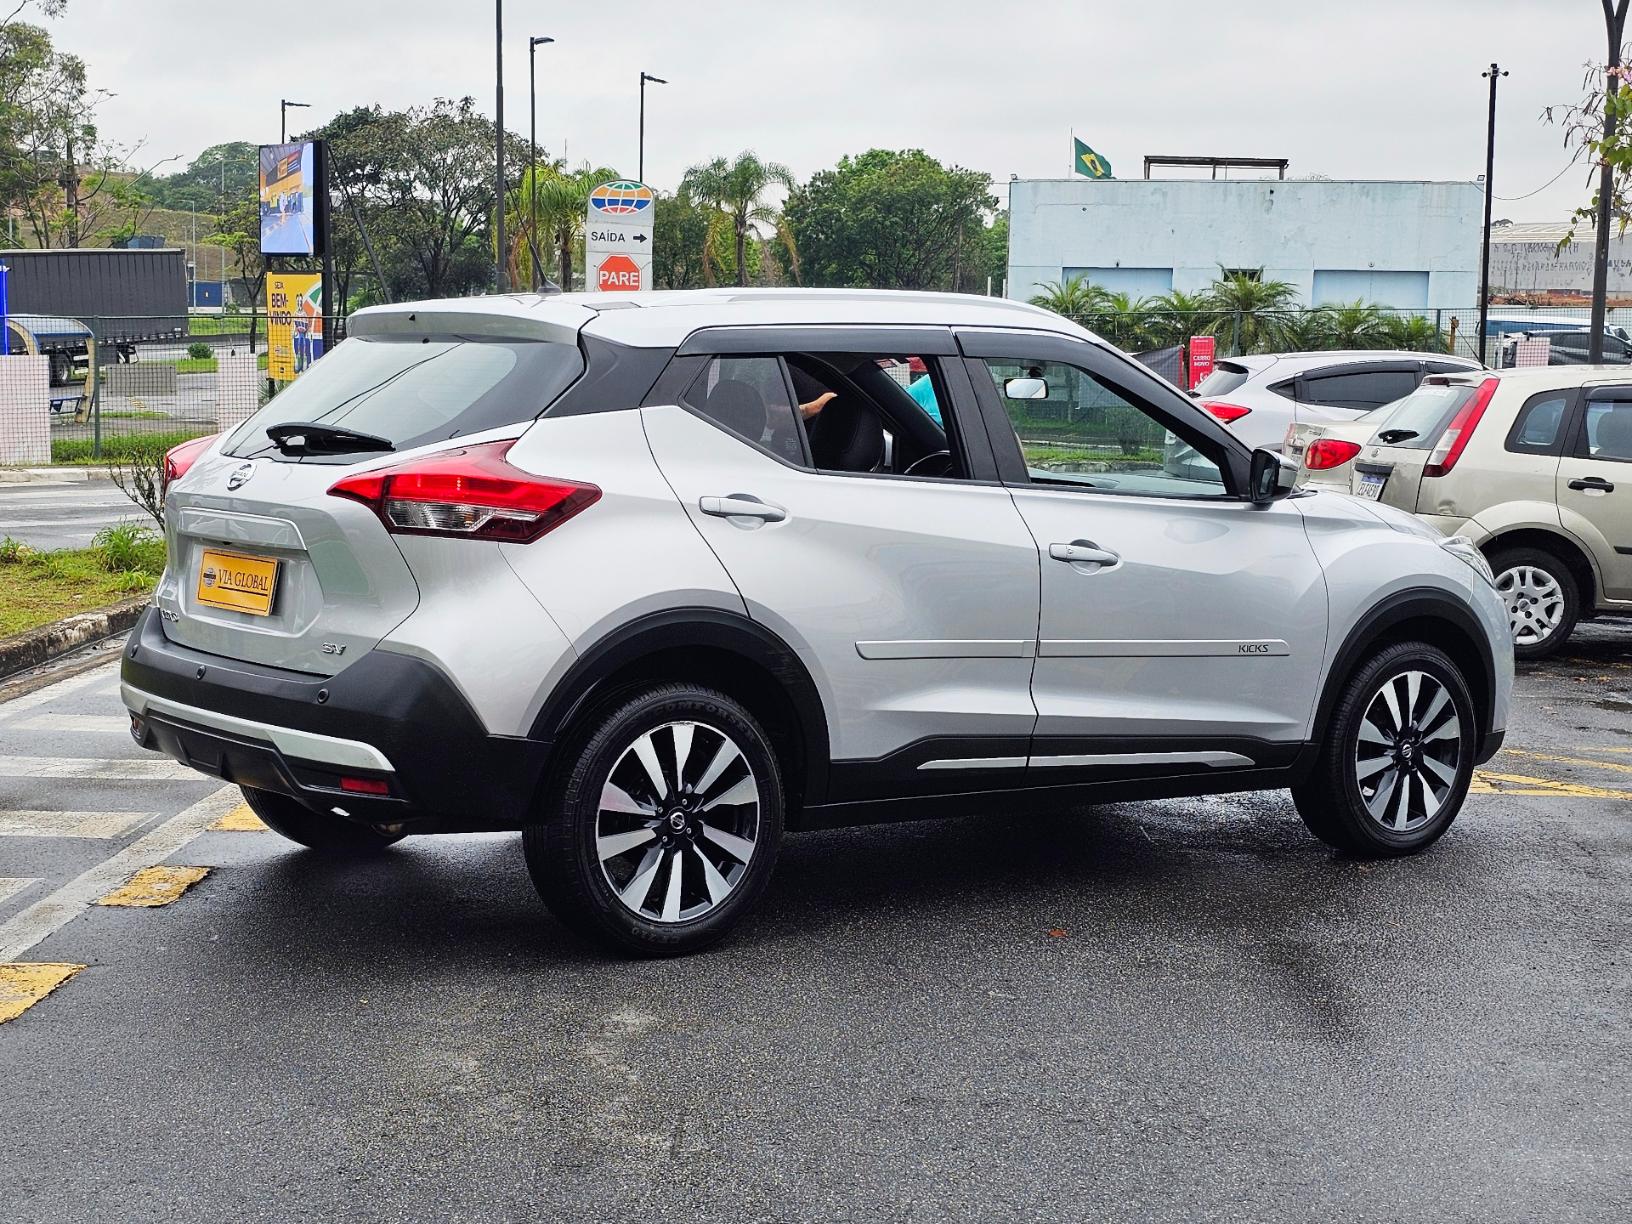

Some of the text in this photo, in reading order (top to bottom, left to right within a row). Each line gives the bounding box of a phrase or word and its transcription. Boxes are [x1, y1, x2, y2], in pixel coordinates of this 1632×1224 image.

[591, 229, 626, 243] SAÍDA
[599, 271, 639, 286] PARE
[270, 311, 292, 326] VINDO
[218, 568, 233, 586] VIA
[234, 571, 269, 592] GLOBAL
[321, 642, 347, 656] SV
[1238, 644, 1269, 653] KICKS
